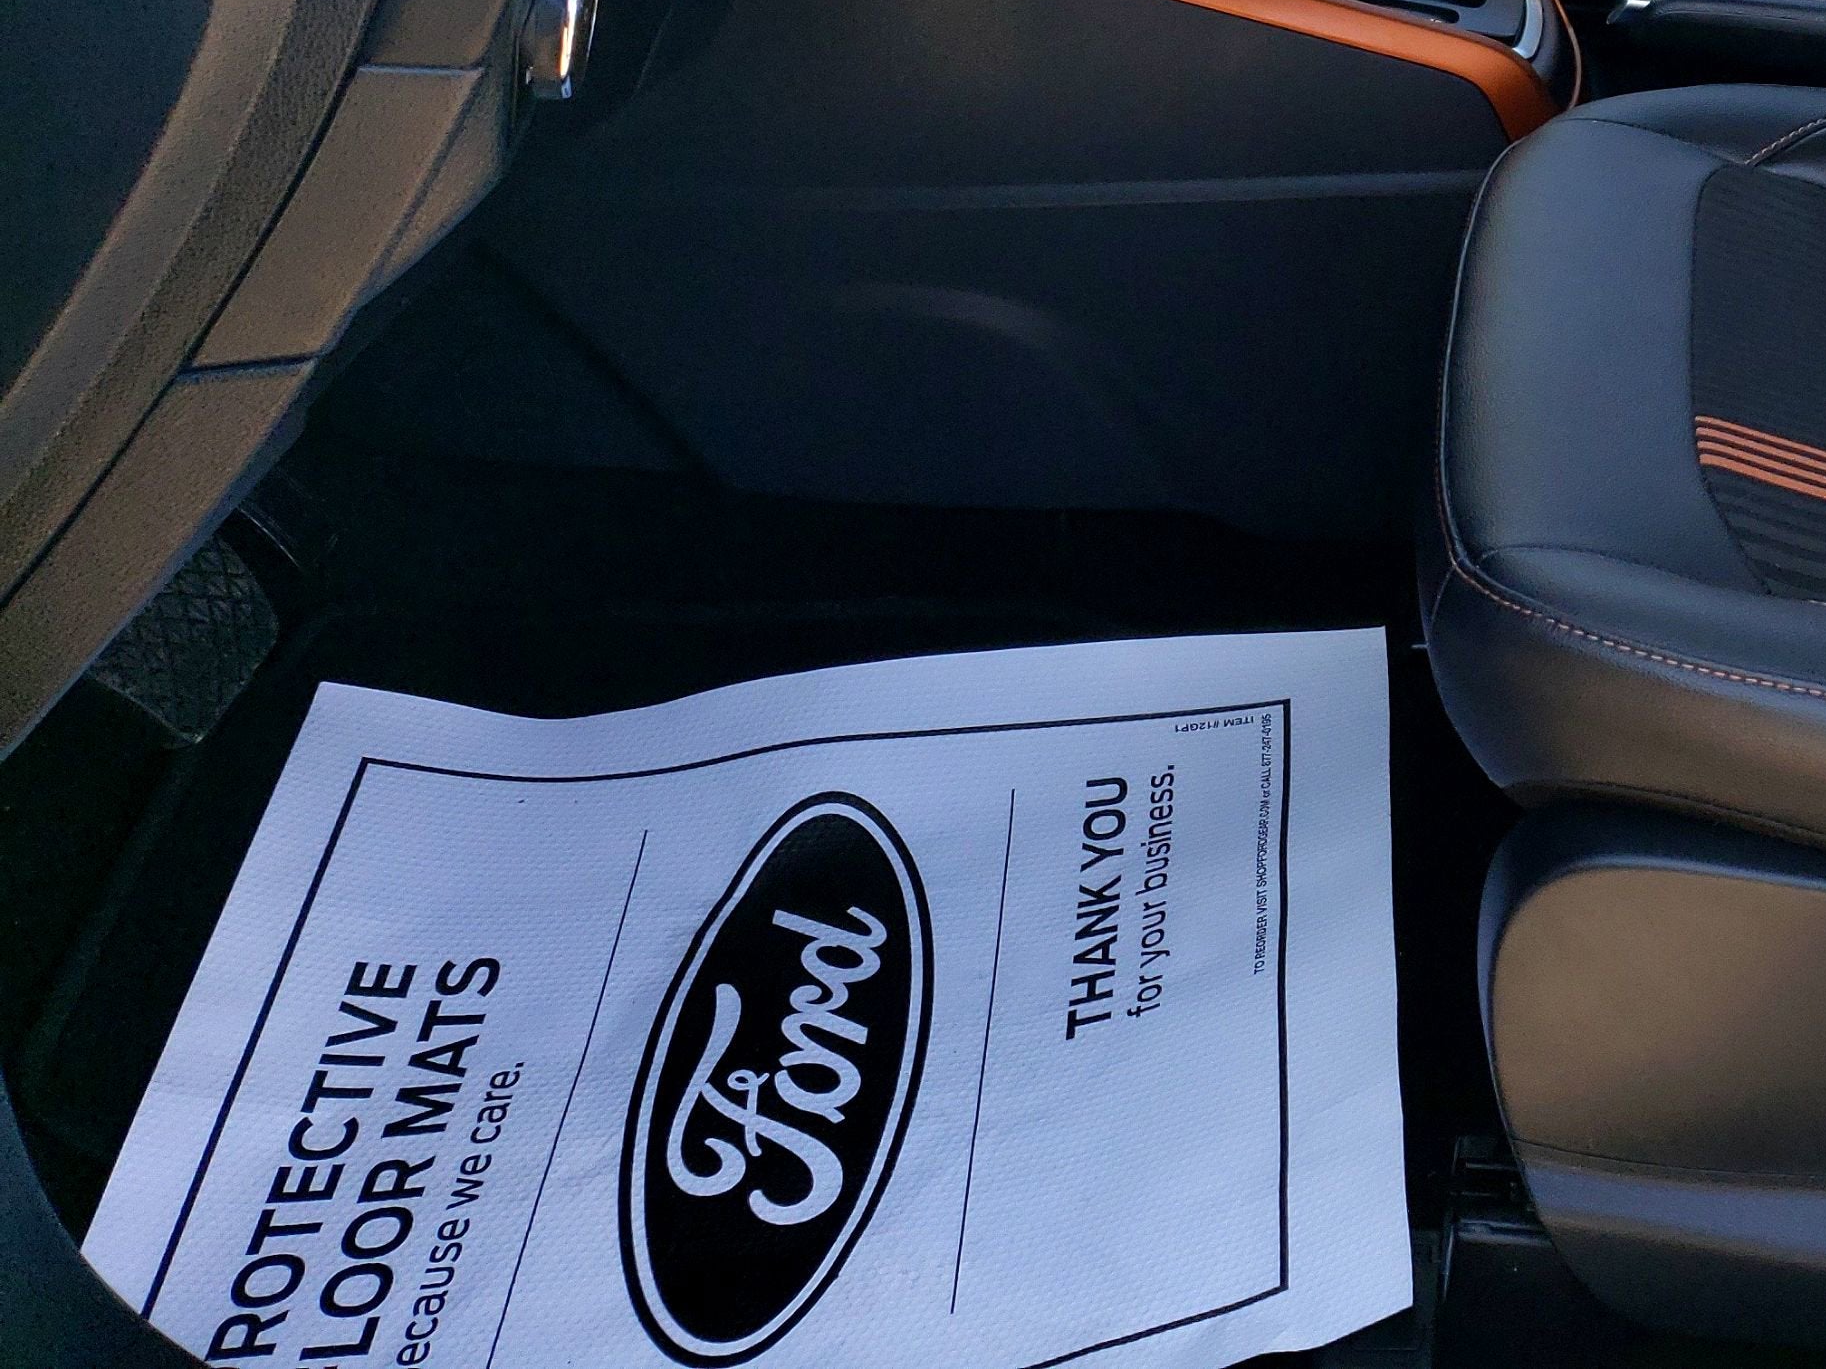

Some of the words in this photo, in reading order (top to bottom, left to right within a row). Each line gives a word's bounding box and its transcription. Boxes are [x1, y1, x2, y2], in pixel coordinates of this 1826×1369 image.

[1223, 715, 1254, 728] ITEM
[1261, 767, 1272, 790] CALL
[1079, 777, 1129, 873] YOU
[1135, 764, 1175, 896] business.
[1256, 800, 1270, 888] SHOPFORDGEAR.COM
[1139, 900, 1172, 966] your
[1255, 914, 1268, 959] REORDER
[1256, 889, 1268, 915] VISIT
[1065, 873, 1123, 1041] THANK
[1127, 974, 1164, 1018] for
[1254, 960, 1265, 975] TO
[666, 906, 888, 1226] Ford
[204, 961, 418, 1369] ROTECTIVE
[296, 1155, 436, 1369] LOOR
[380, 957, 501, 1139] MATS
[396, 1217, 471, 1369] ecause
[445, 1153, 493, 1210] we
[469, 1061, 526, 1145] care.
